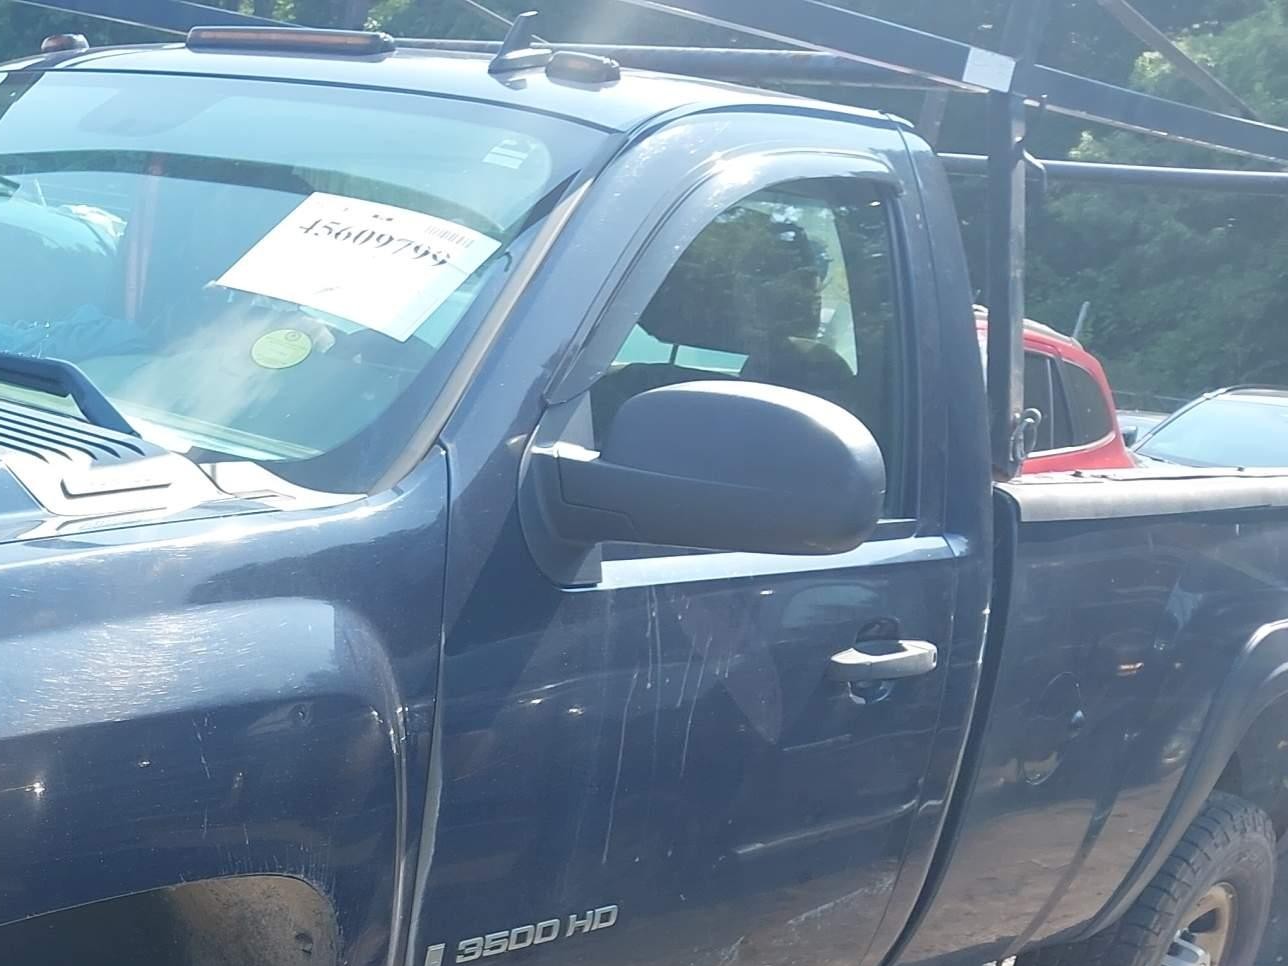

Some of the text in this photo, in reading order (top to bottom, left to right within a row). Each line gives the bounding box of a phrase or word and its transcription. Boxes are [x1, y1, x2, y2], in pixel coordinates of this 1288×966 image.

[297, 217, 452, 268] 45609799
[455, 904, 620, 964] 3500 HD
